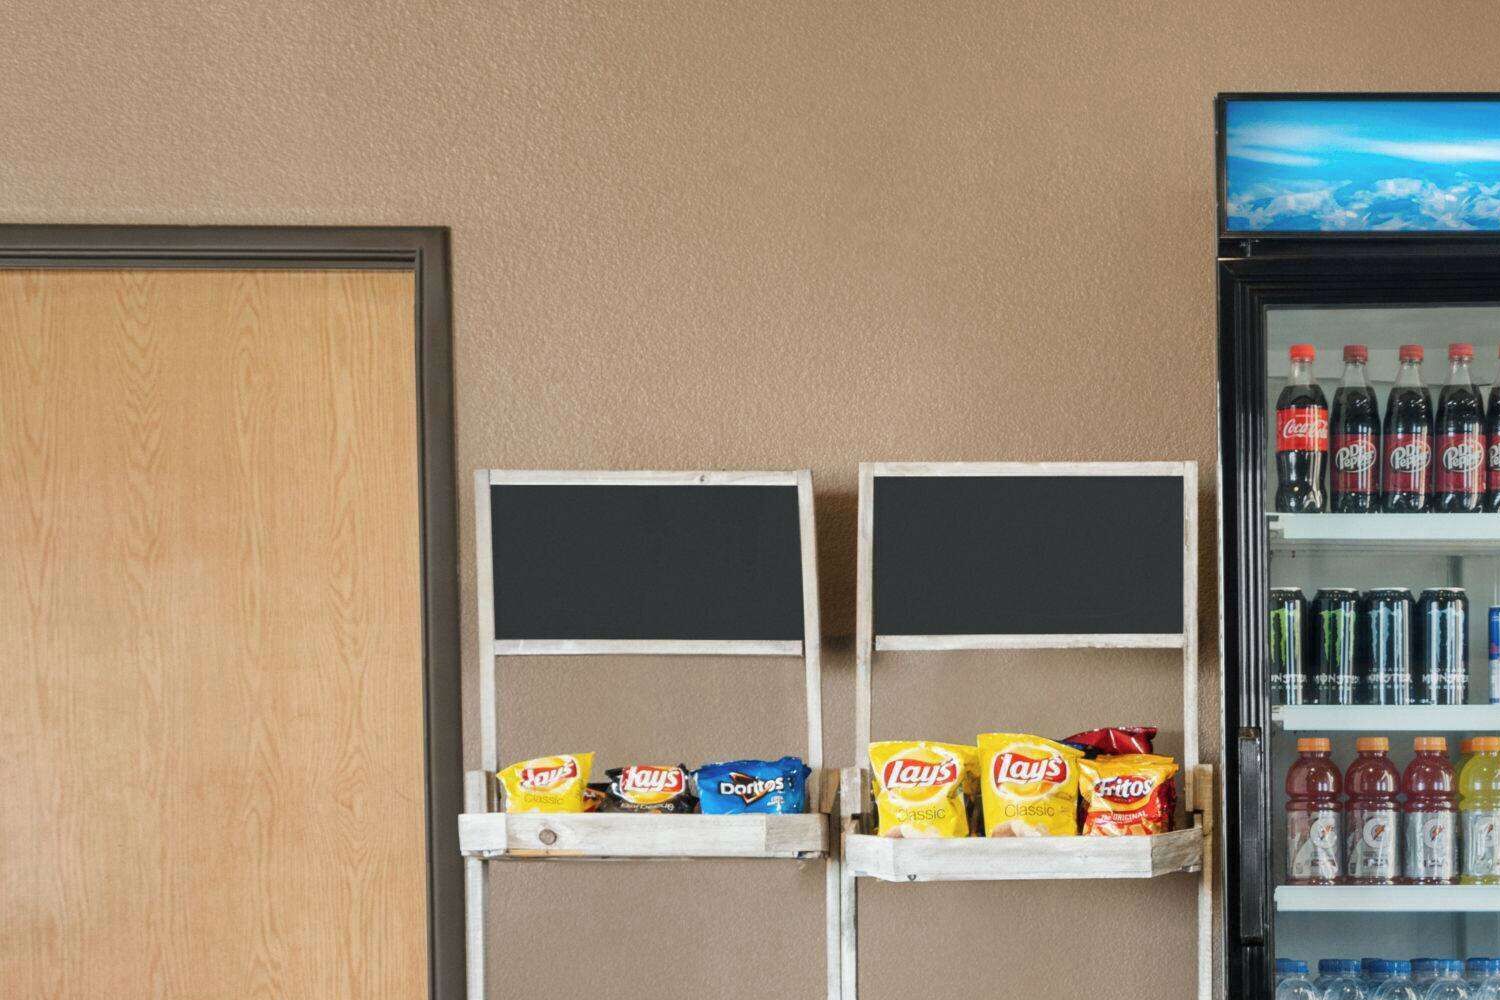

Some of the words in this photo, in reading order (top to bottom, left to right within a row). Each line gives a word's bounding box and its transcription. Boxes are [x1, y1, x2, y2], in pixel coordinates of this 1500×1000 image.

[720, 777, 784, 797] Doritos
[1098, 777, 1154, 799] Fritos
[897, 806, 946, 822] Classic
[1004, 803, 1055, 818] Classic
